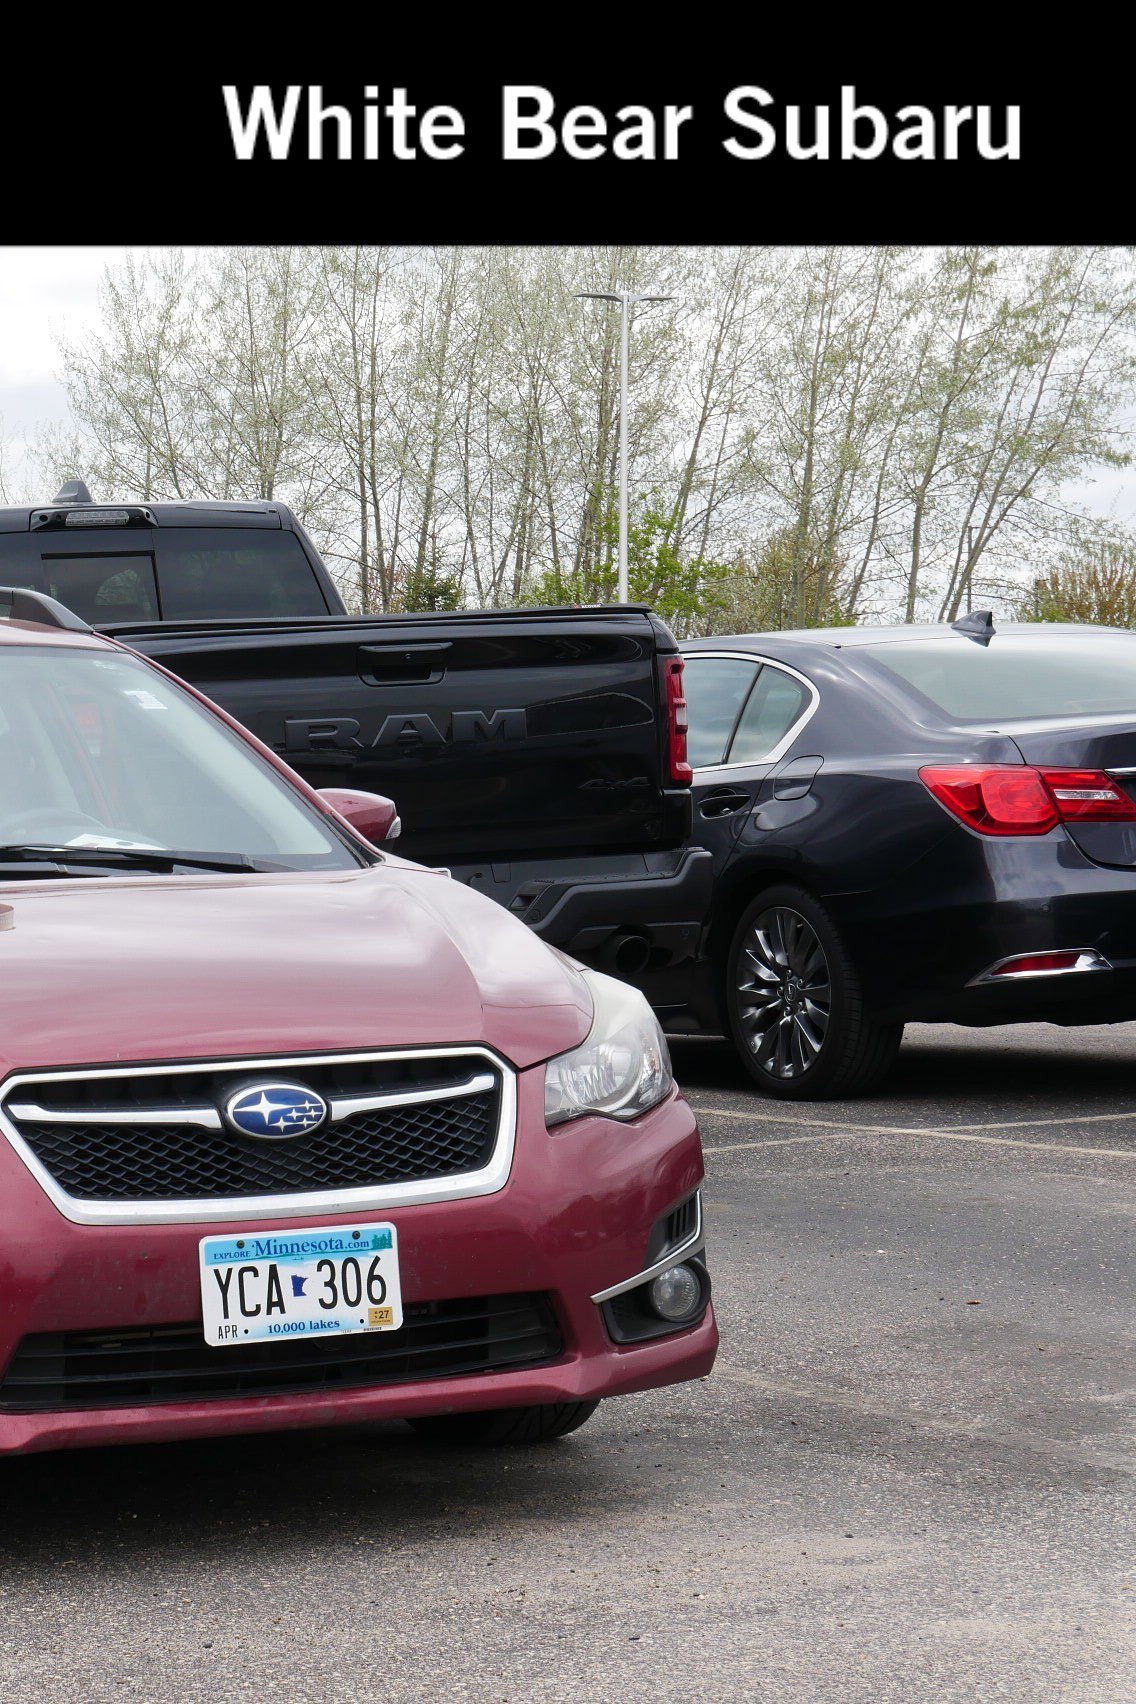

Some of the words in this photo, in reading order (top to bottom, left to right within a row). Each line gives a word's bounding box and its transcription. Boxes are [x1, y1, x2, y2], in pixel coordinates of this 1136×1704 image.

[285, 708, 527, 748] RAM
[213, 1250, 250, 1260] EXPLORE
[254, 1237, 370, 1257] Minnesota.com
[213, 1263, 286, 1319] YCA
[316, 1255, 387, 1310] 306
[378, 1310, 389, 1319] 27
[218, 1324, 238, 1340] APR
[268, 1322, 306, 1334] 10,000
[309, 1319, 341, 1330] lakes
